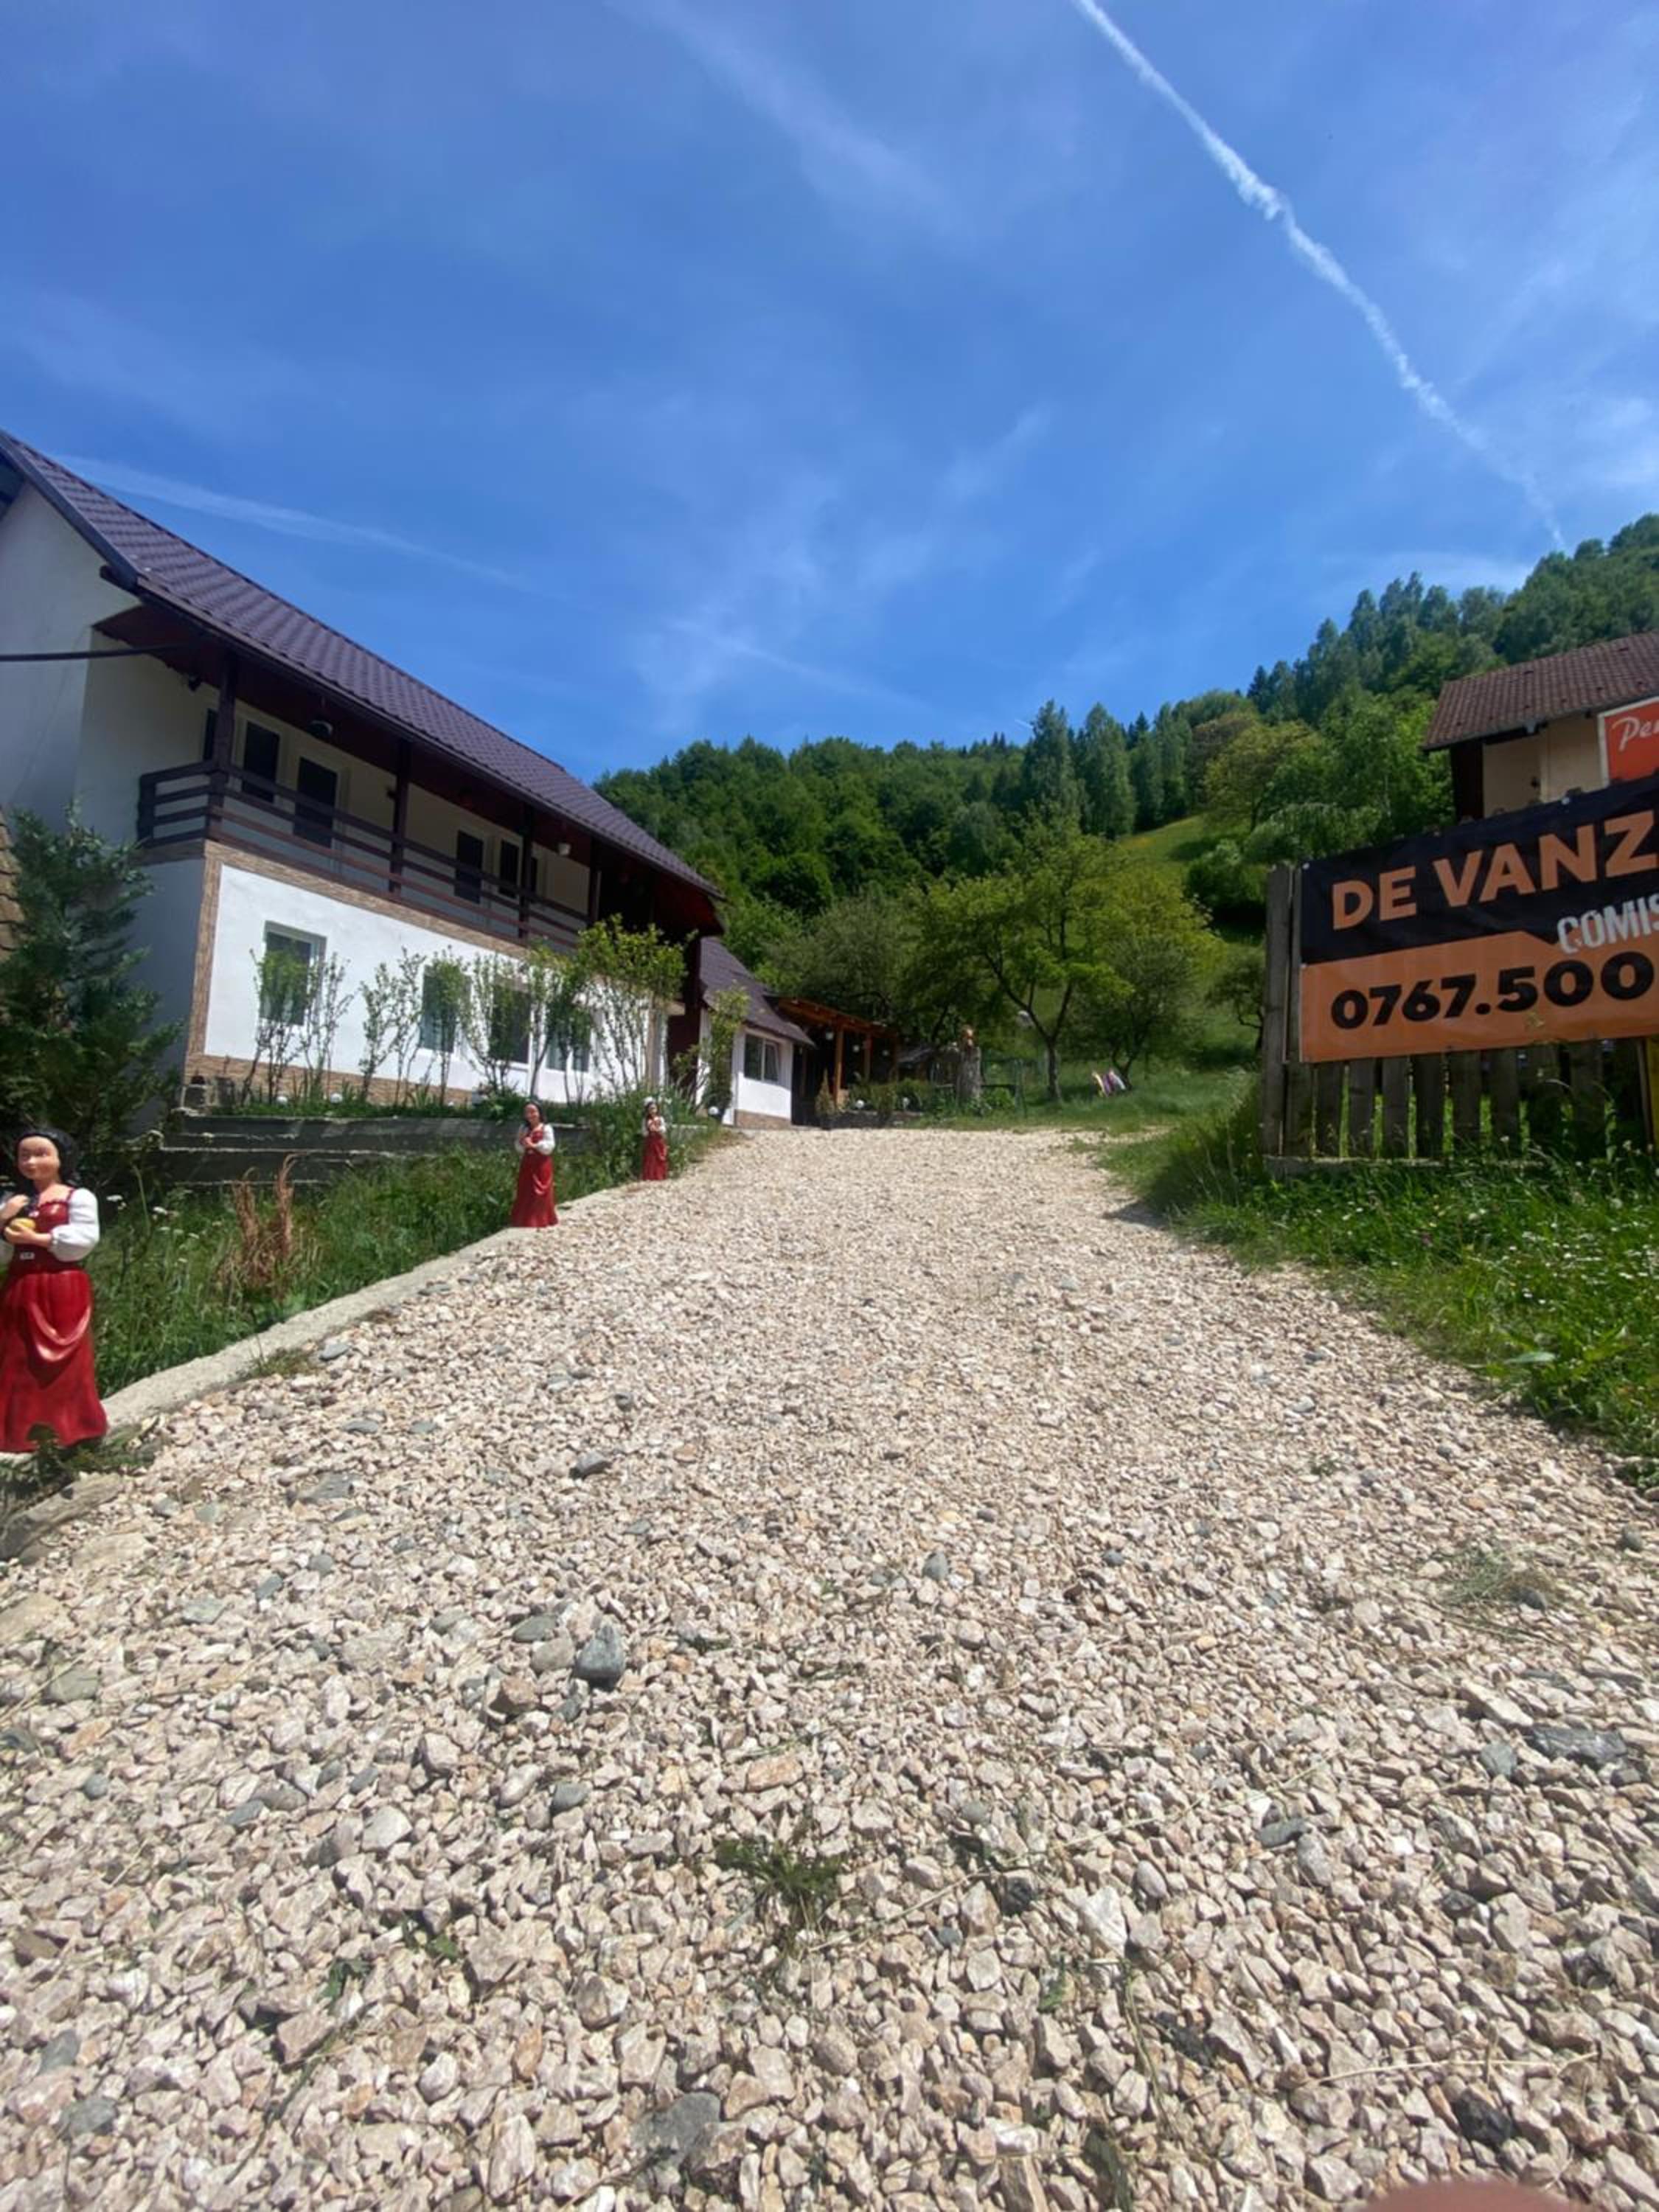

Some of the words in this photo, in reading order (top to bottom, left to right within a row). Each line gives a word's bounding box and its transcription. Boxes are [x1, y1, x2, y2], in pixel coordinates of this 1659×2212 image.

[1332, 866, 1416, 930] DE
[1433, 810, 1659, 908] VANZ
[1331, 951, 1655, 1029] 0767.500
